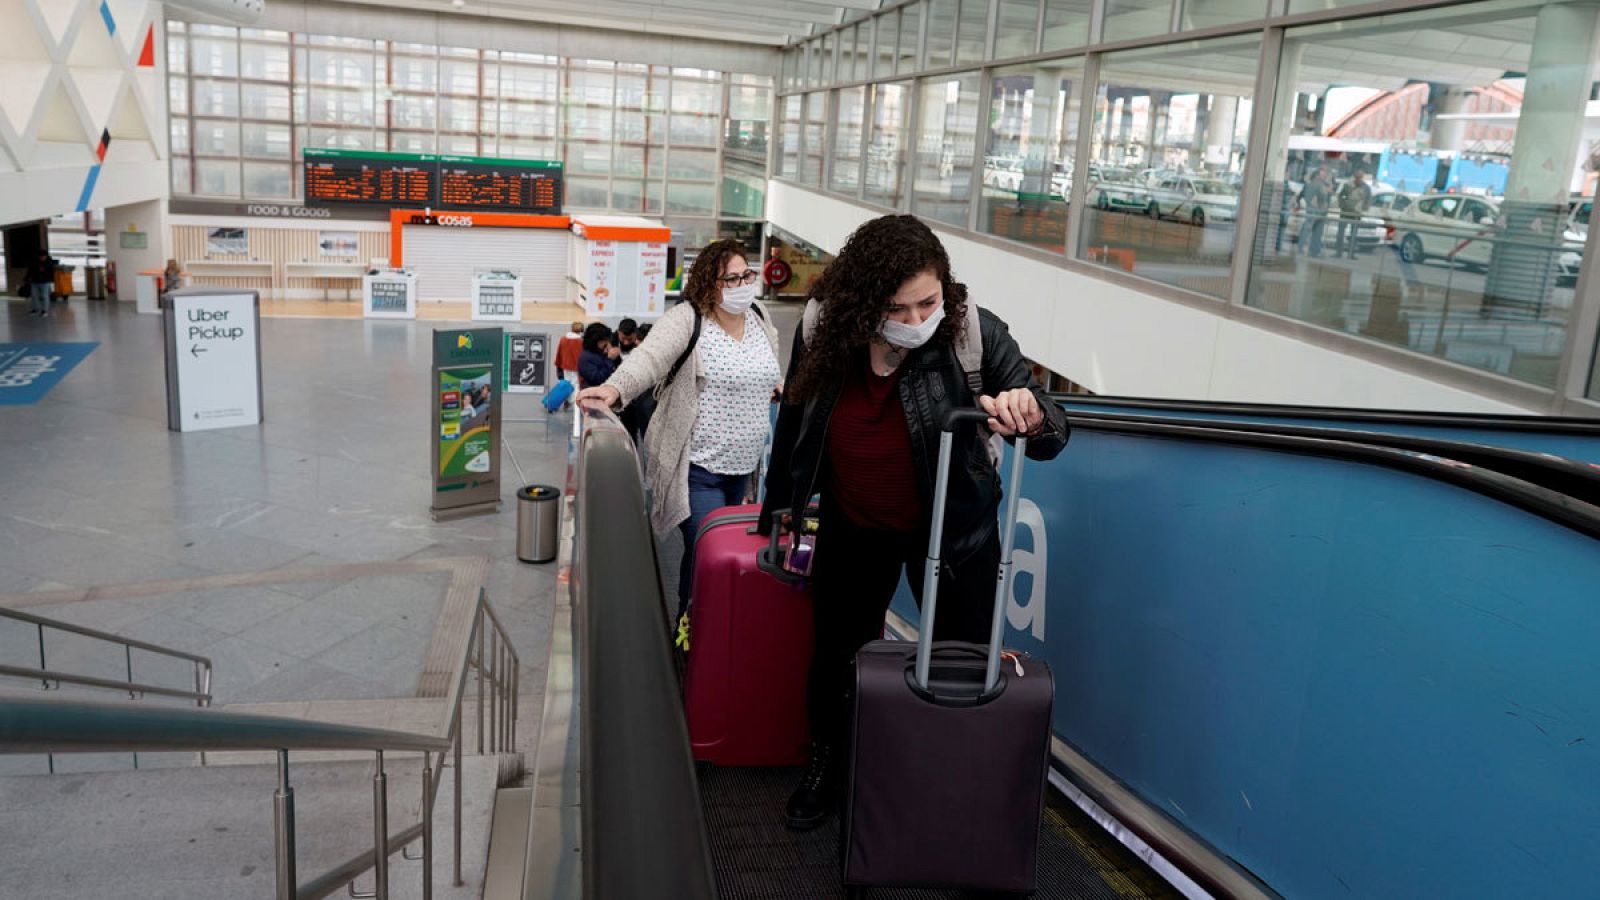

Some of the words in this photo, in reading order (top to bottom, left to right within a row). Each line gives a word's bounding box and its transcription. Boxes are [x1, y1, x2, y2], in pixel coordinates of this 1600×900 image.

[247, 204, 279, 216] FOOD
[281, 205, 290, 216] &
[292, 206, 331, 217] GOODS
[187, 308, 230, 322] Uber
[187, 325, 244, 341] Pickup
